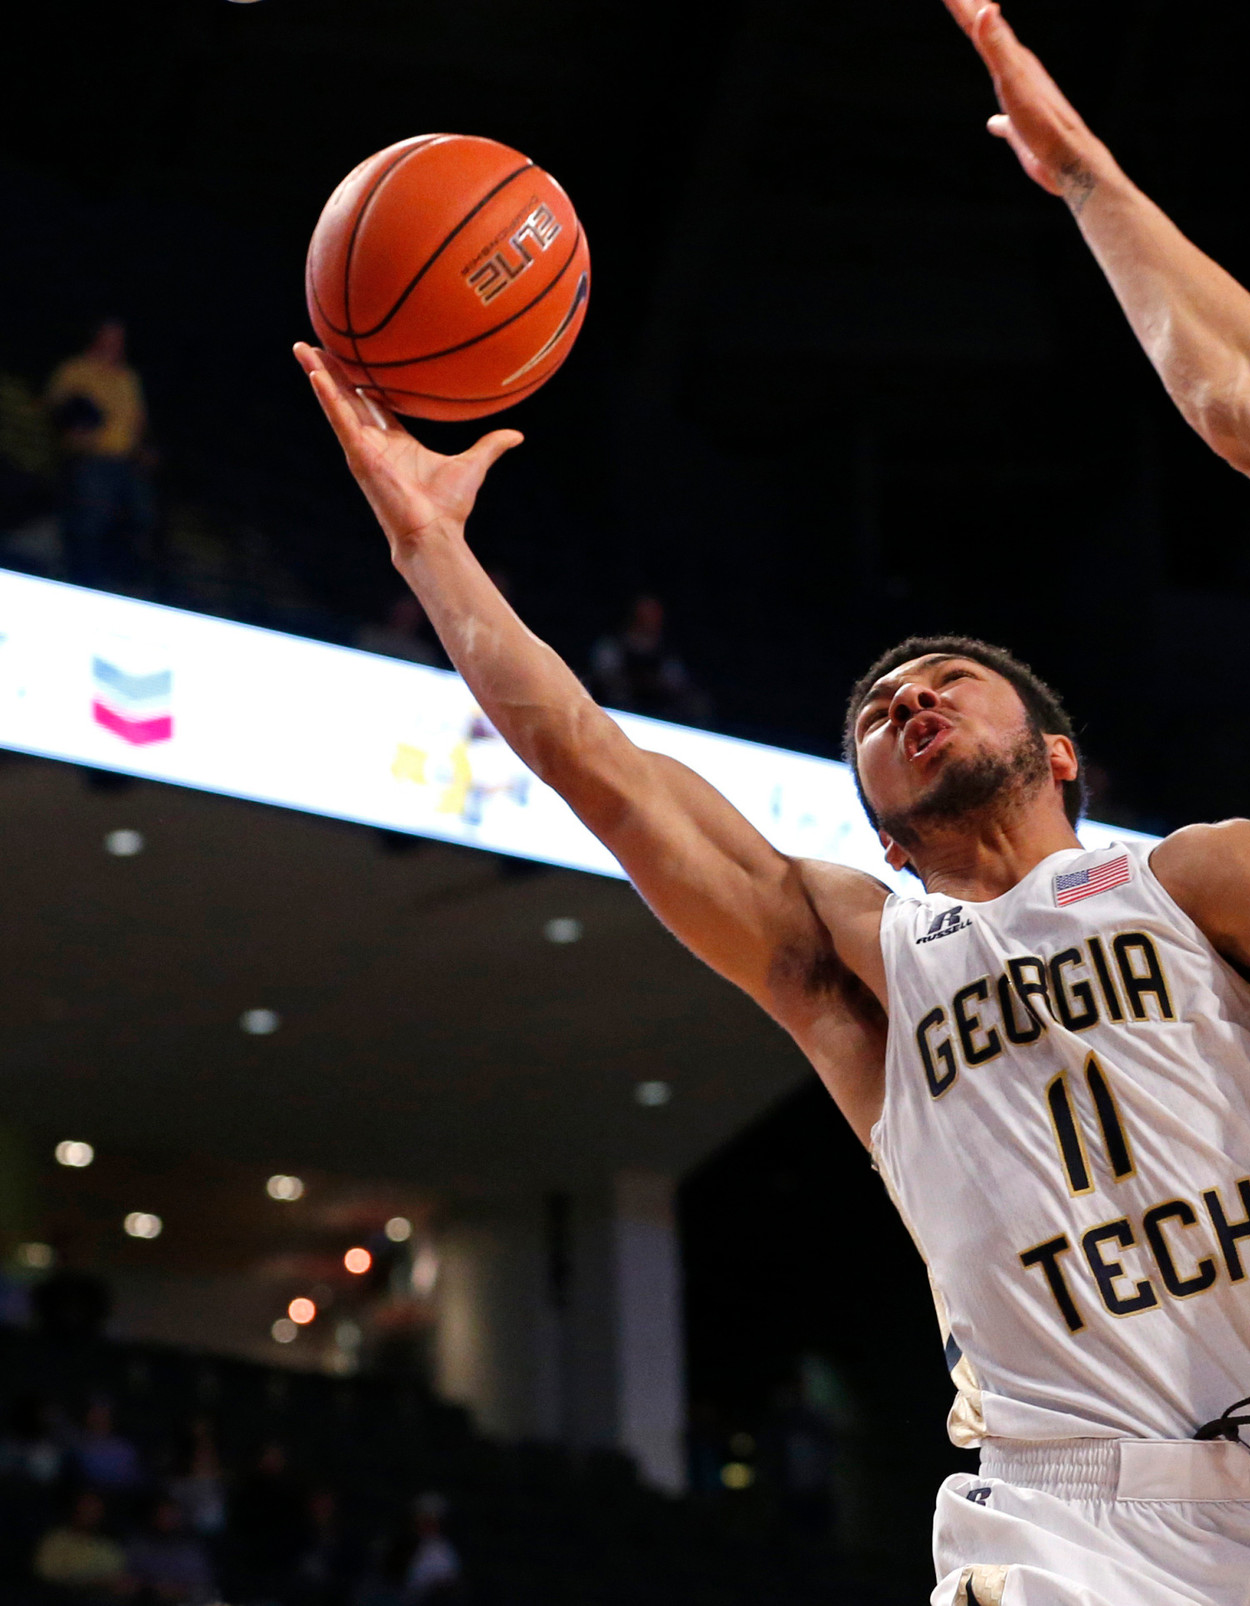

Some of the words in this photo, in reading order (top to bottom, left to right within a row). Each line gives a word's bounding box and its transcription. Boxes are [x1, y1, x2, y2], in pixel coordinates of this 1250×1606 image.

[467, 201, 563, 308] ELITE
[915, 918, 973, 945] RUSSELL
[914, 930, 1178, 1101] GEORGIA
[1044, 1048, 1138, 1198] 11
